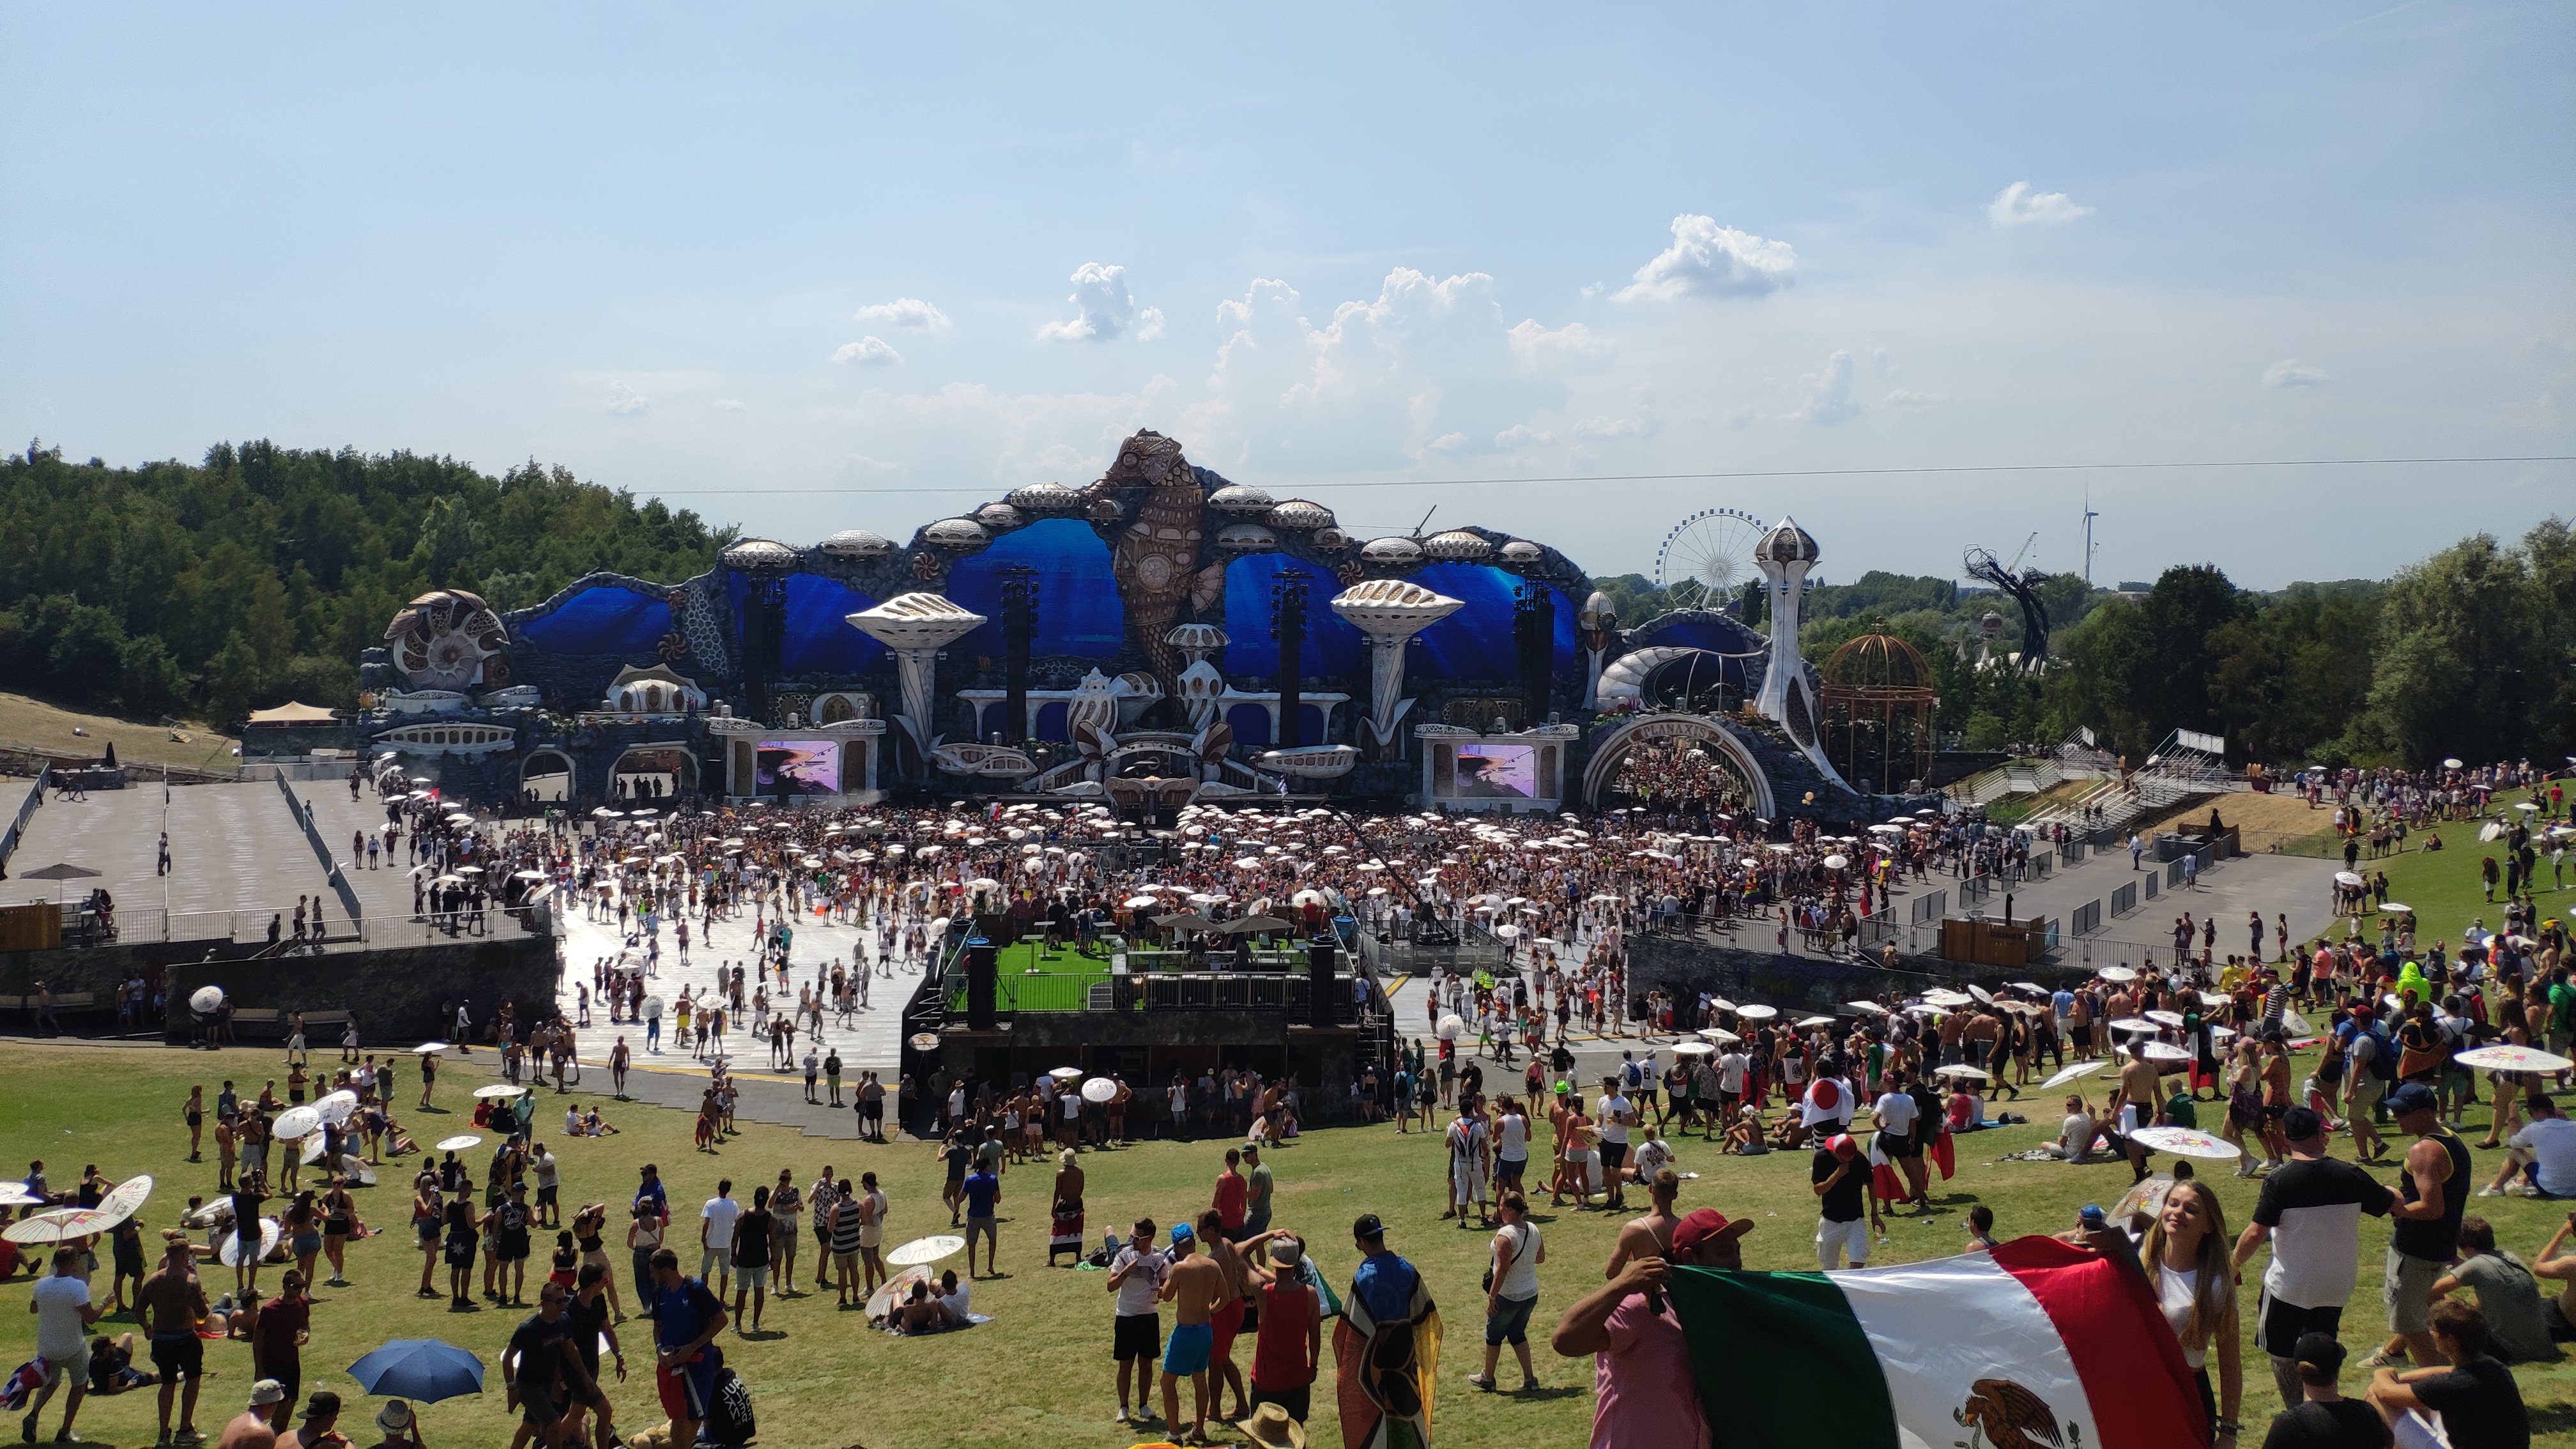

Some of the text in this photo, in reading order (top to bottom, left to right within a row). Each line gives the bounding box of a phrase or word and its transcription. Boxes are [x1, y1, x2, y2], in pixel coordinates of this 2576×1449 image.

[1643, 723, 1706, 738] PLANAXIS
[1990, 931, 2023, 940] DRINKS
[1644, 1068, 1650, 1080] 8
